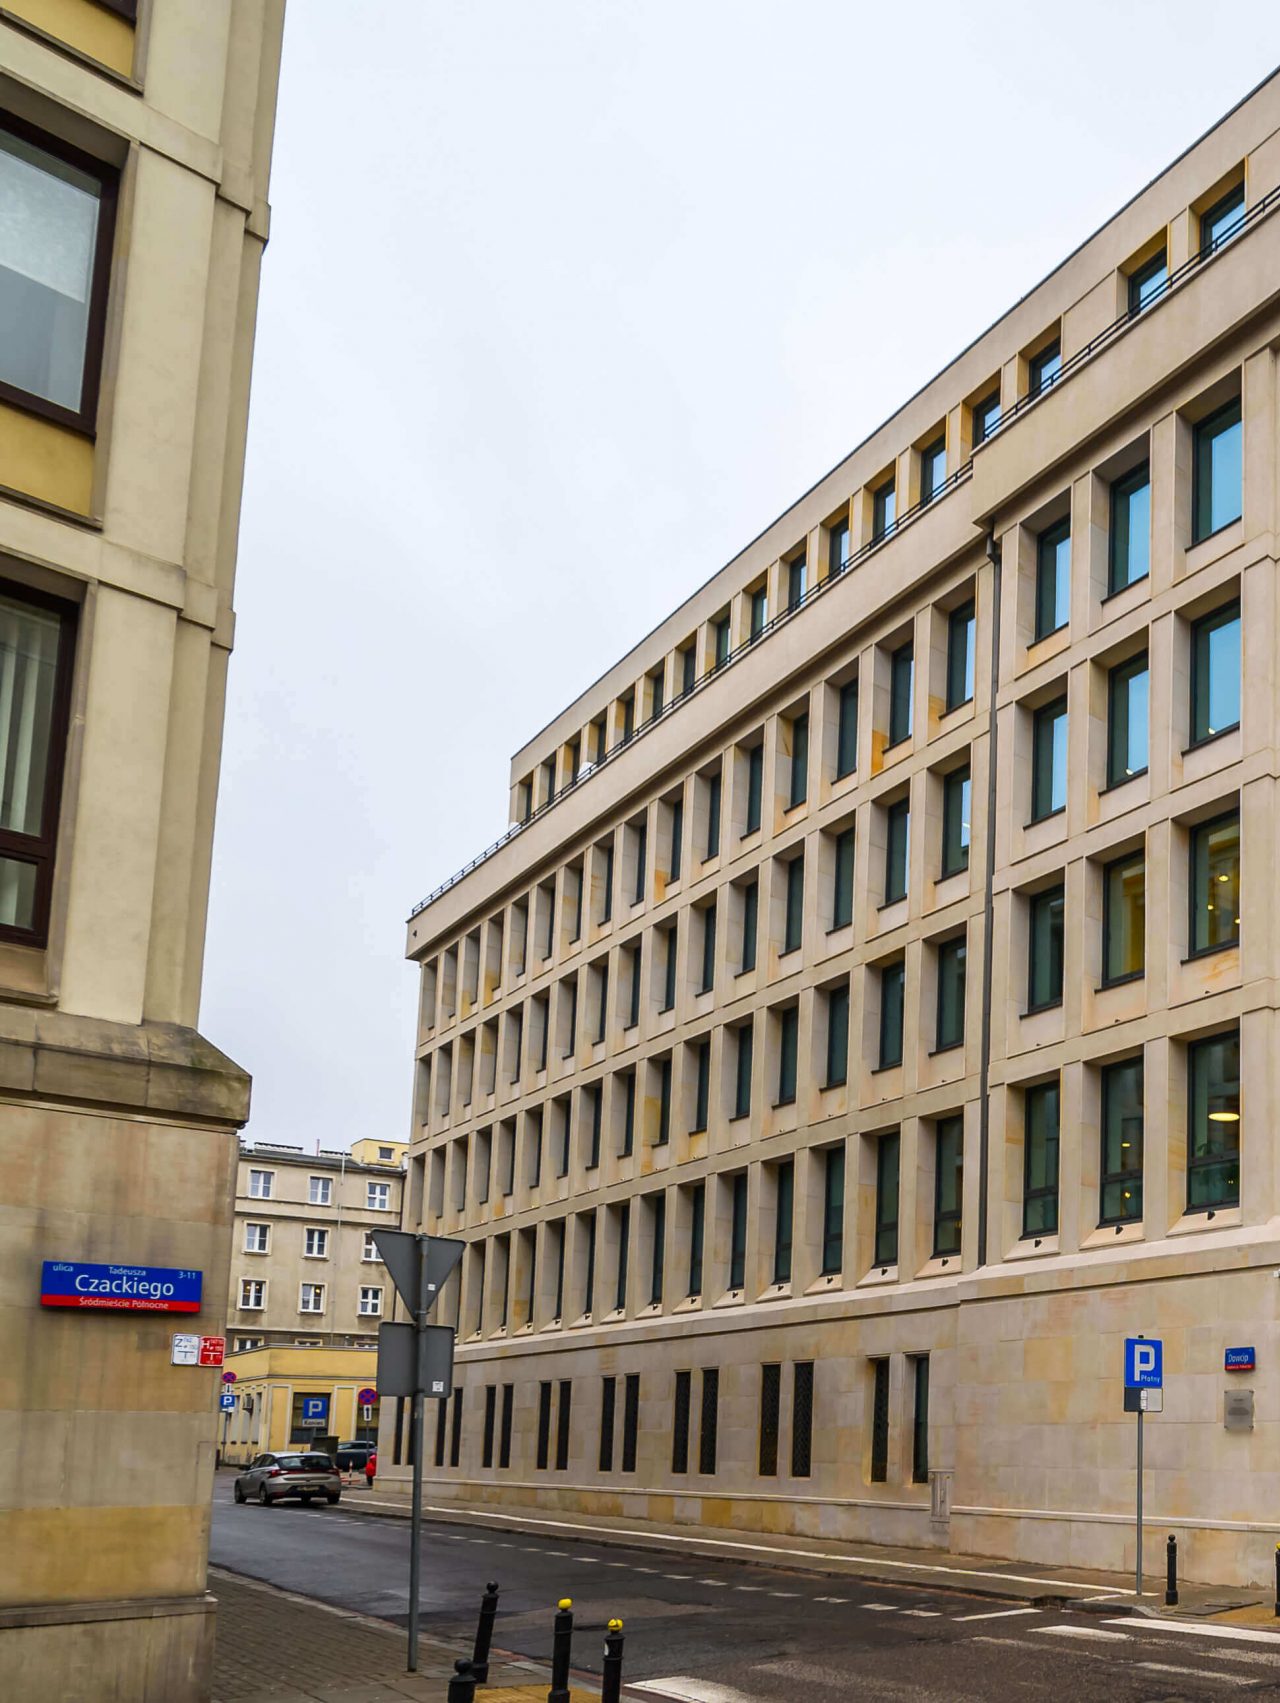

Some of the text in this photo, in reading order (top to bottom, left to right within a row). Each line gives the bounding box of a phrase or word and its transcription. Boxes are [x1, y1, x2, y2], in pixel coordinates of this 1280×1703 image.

[52, 1264, 74, 1272] ulica
[109, 1266, 147, 1276] Tadeusza
[177, 1271, 196, 1279] 3-11
[75, 1274, 174, 1299] Czackiego
[79, 1297, 169, 1310] Śródmieście Północne
[1134, 1345, 1155, 1381] P
[308, 1401, 322, 1416] P
